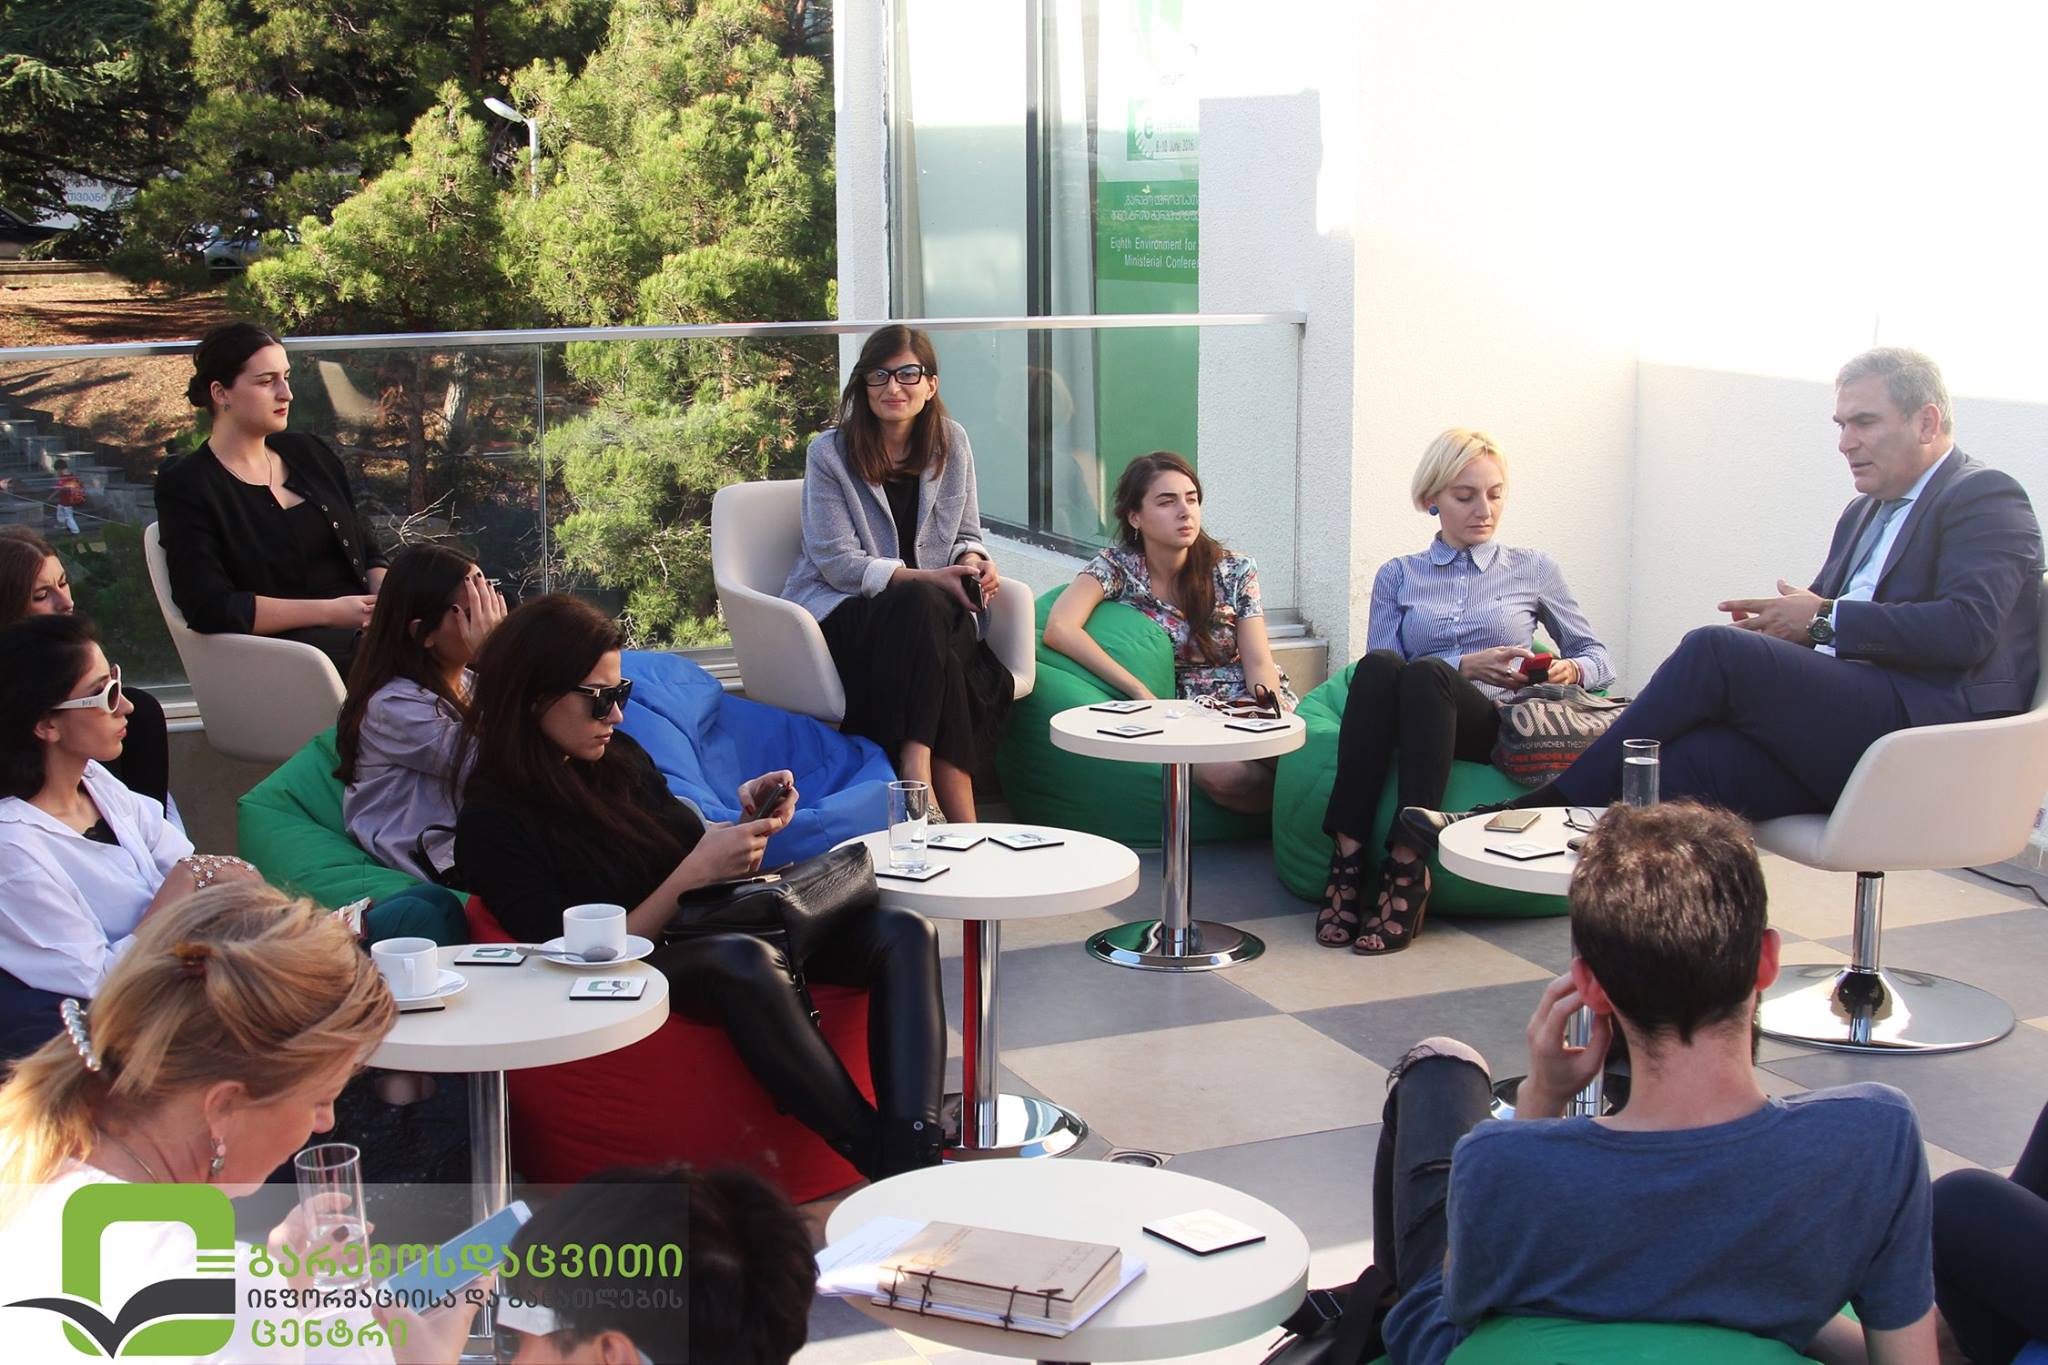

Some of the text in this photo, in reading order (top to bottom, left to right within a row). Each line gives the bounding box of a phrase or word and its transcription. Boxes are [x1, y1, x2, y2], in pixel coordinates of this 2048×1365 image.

[1110, 236, 1196, 252] Eighth Environment for
[1124, 254, 1199, 269] Ministerial Confere
